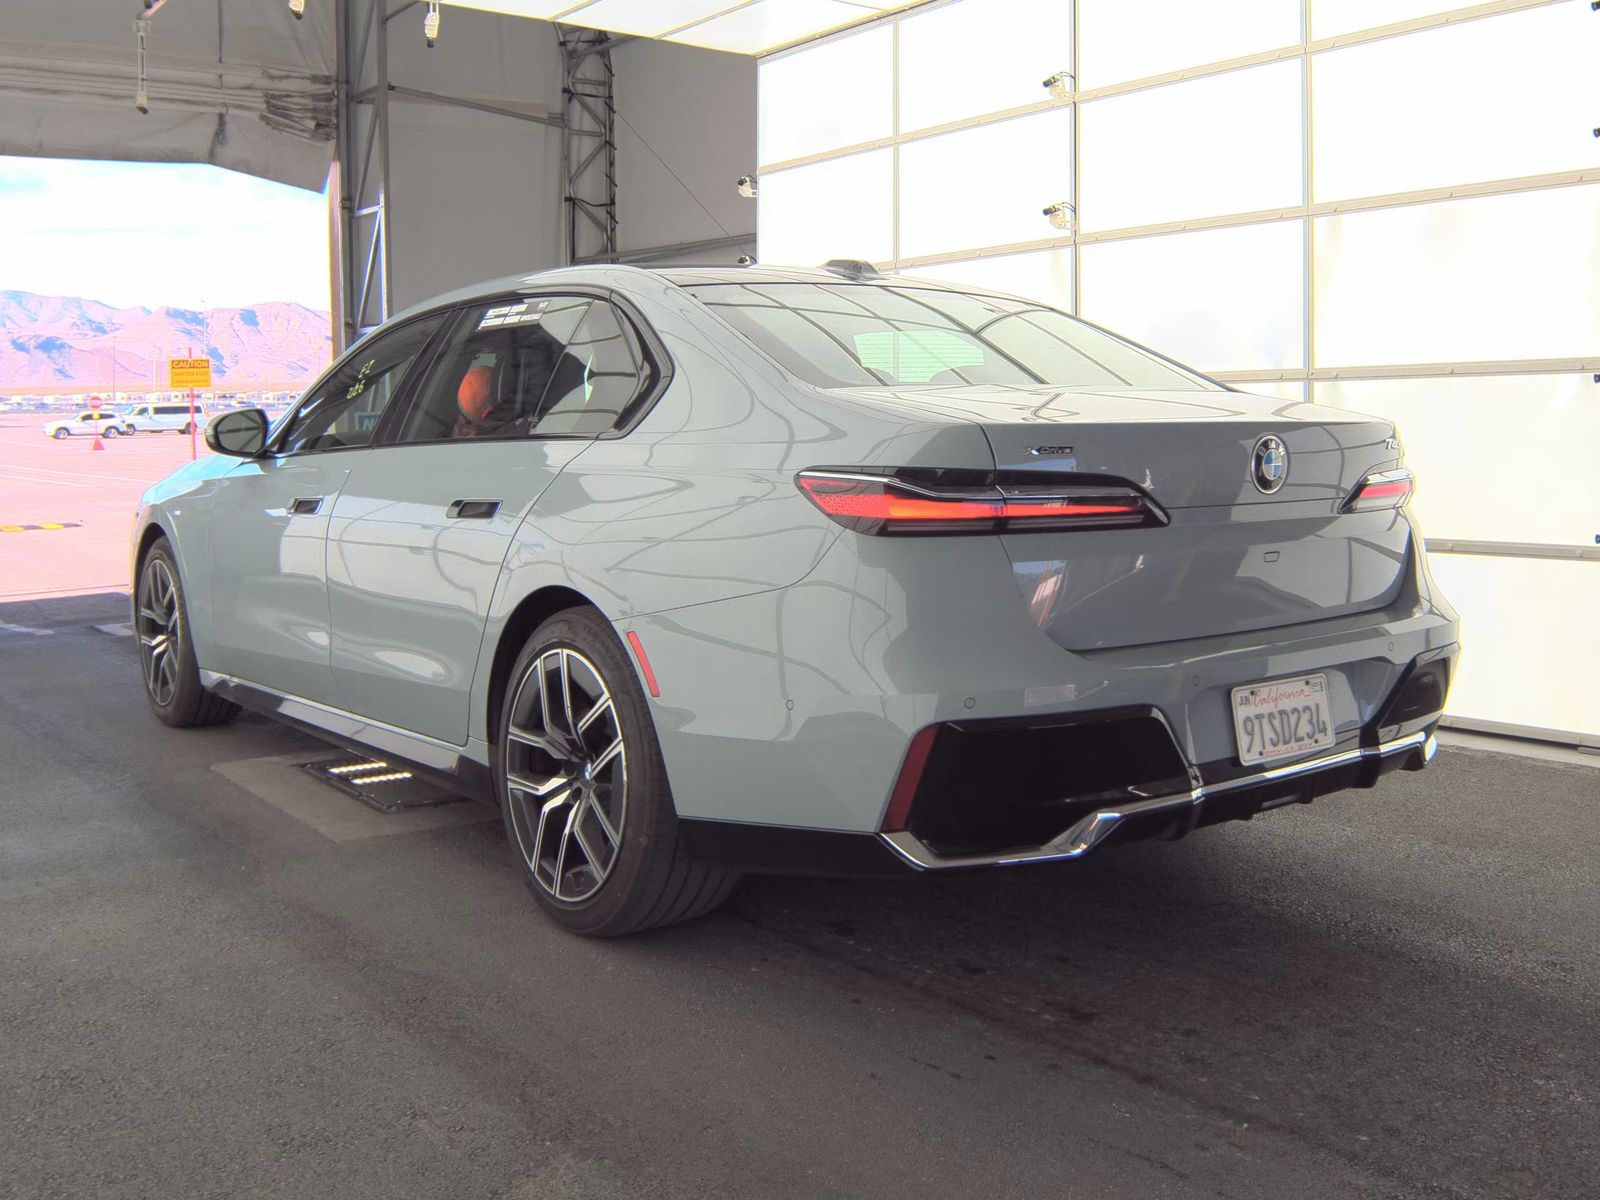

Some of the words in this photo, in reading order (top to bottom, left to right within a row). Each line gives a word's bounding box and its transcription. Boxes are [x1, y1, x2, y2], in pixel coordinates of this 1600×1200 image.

[172, 360, 208, 368] CAUTION
[1253, 686, 1311, 708] California
[1243, 702, 1328, 754] 9TSD234
